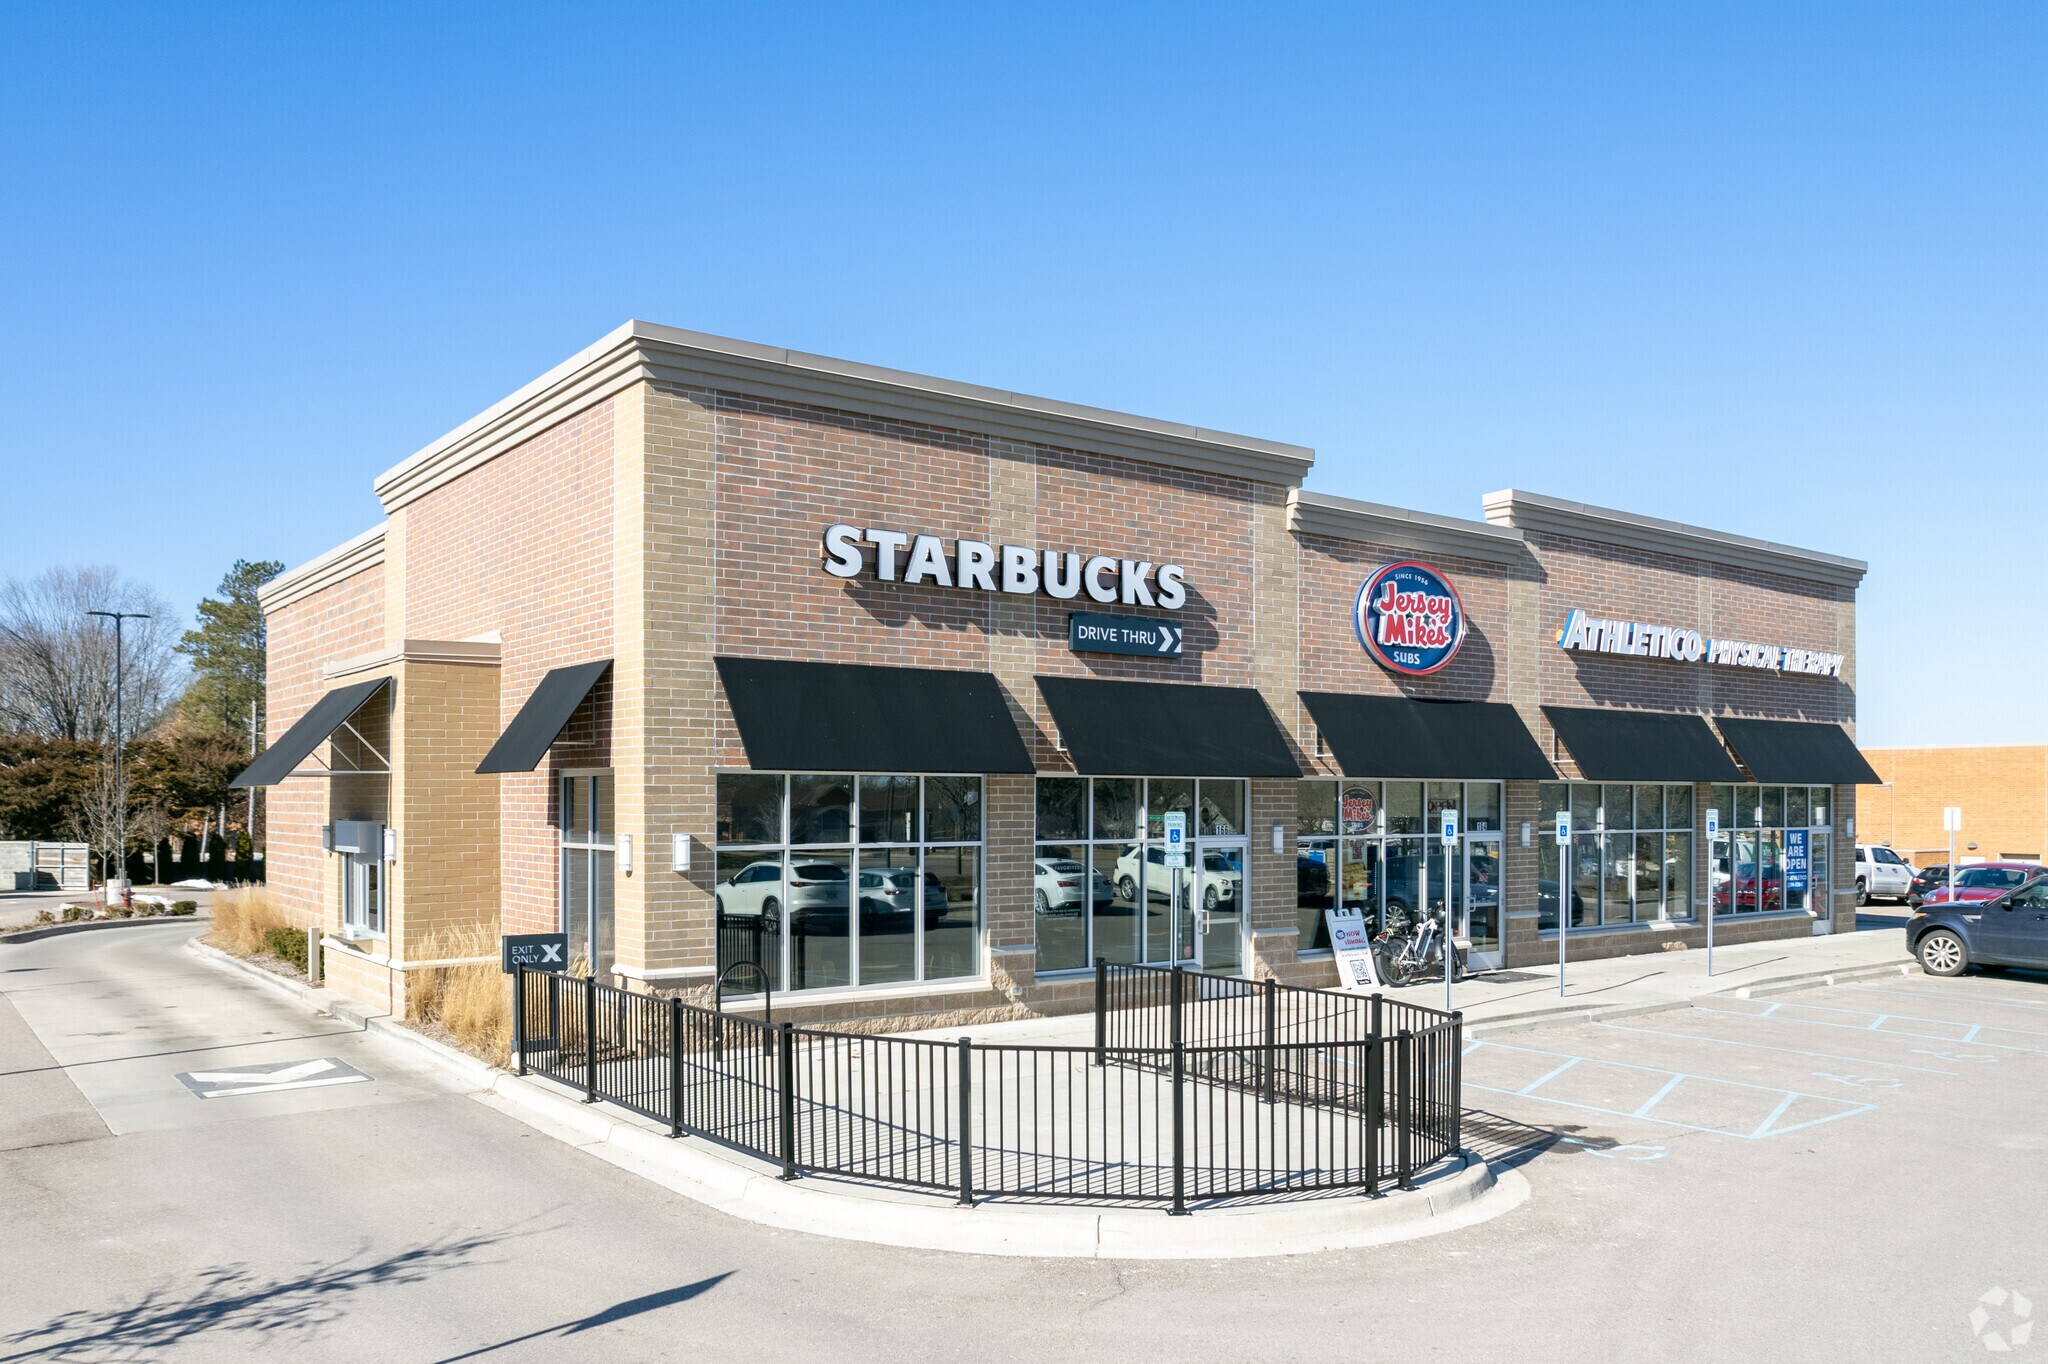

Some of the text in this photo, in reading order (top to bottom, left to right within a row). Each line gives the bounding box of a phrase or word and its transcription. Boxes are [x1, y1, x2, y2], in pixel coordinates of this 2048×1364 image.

[823, 523, 1186, 610] STARBUCKS
[1414, 574, 1429, 586] 1956
[1379, 581, 1452, 625] Jersey
[1078, 625, 1156, 645] DRIVE THRU
[1383, 612, 1452, 648] Mike's
[1562, 609, 1844, 677] ATHLETICO PHYSICAL THERAPY
[1393, 651, 1420, 664] SUBS
[1342, 794, 1373, 812] Jersey
[1216, 825, 1229, 835] 166
[1790, 833, 1802, 844] WE
[1788, 846, 1804, 857] ARE
[1786, 858, 1807, 869] OPEN
[512, 945, 534, 954] EXIT
[512, 954, 540, 964] ONLY
